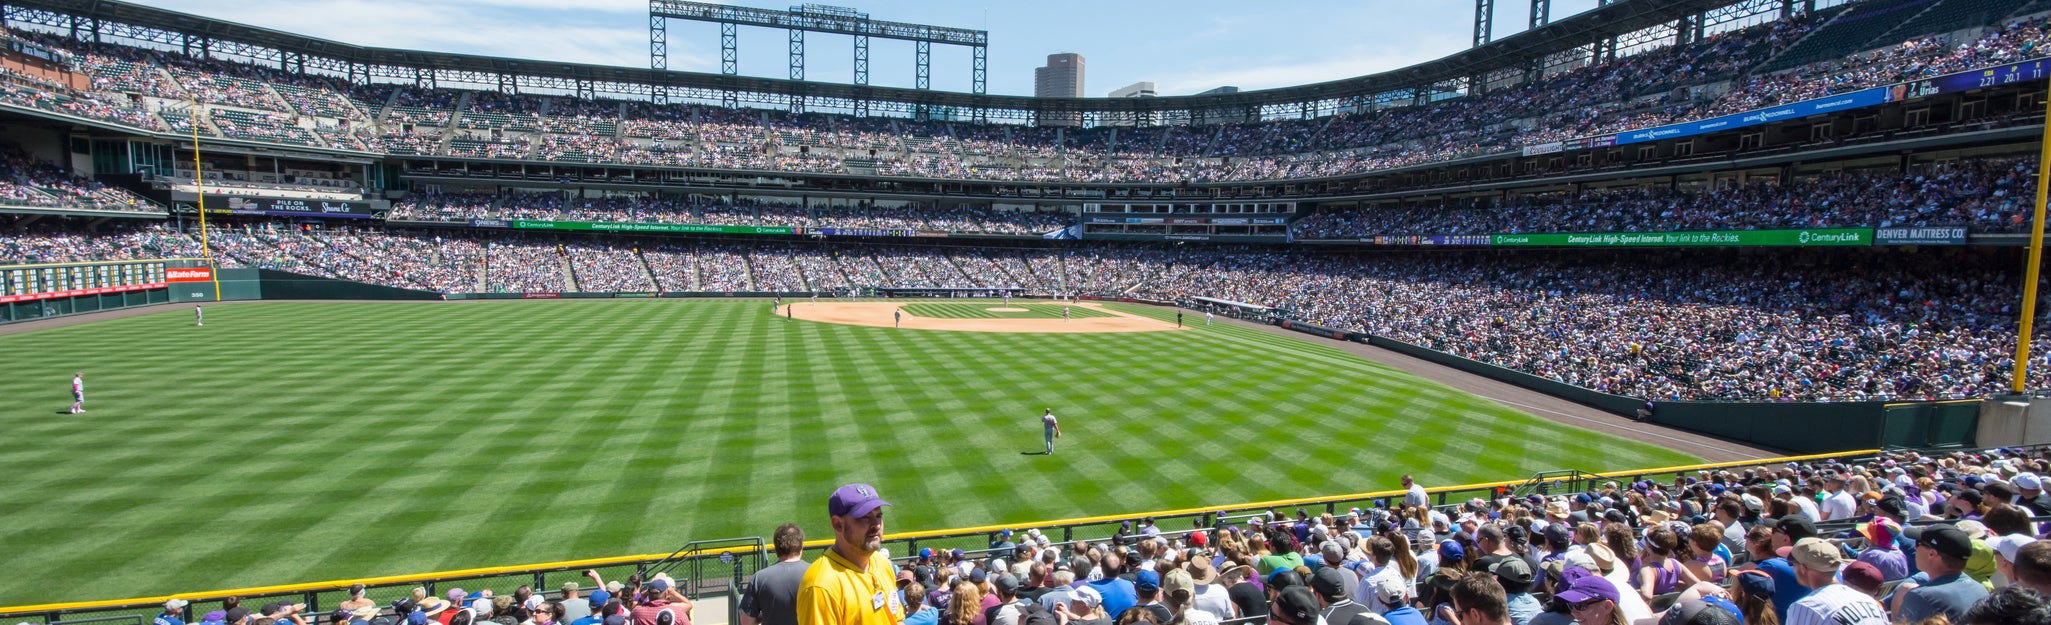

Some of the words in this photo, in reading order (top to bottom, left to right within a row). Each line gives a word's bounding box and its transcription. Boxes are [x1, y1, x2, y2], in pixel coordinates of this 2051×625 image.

[1980, 77, 1995, 87] 2.21
[2004, 73, 2020, 83] 20.1
[2033, 69, 2042, 79] 11
[1910, 83, 1917, 91] 7
[1568, 235, 1602, 244] CenturyLink
[1603, 235, 1640, 244] High-Speed
[1665, 234, 1679, 243] Your
[1680, 234, 1691, 242] link
[1699, 234, 1710, 242] the
[1811, 232, 1860, 243] CenturyLink
[1877, 229, 1908, 239] DENVER
[1909, 228, 1950, 239] MATTRESS
